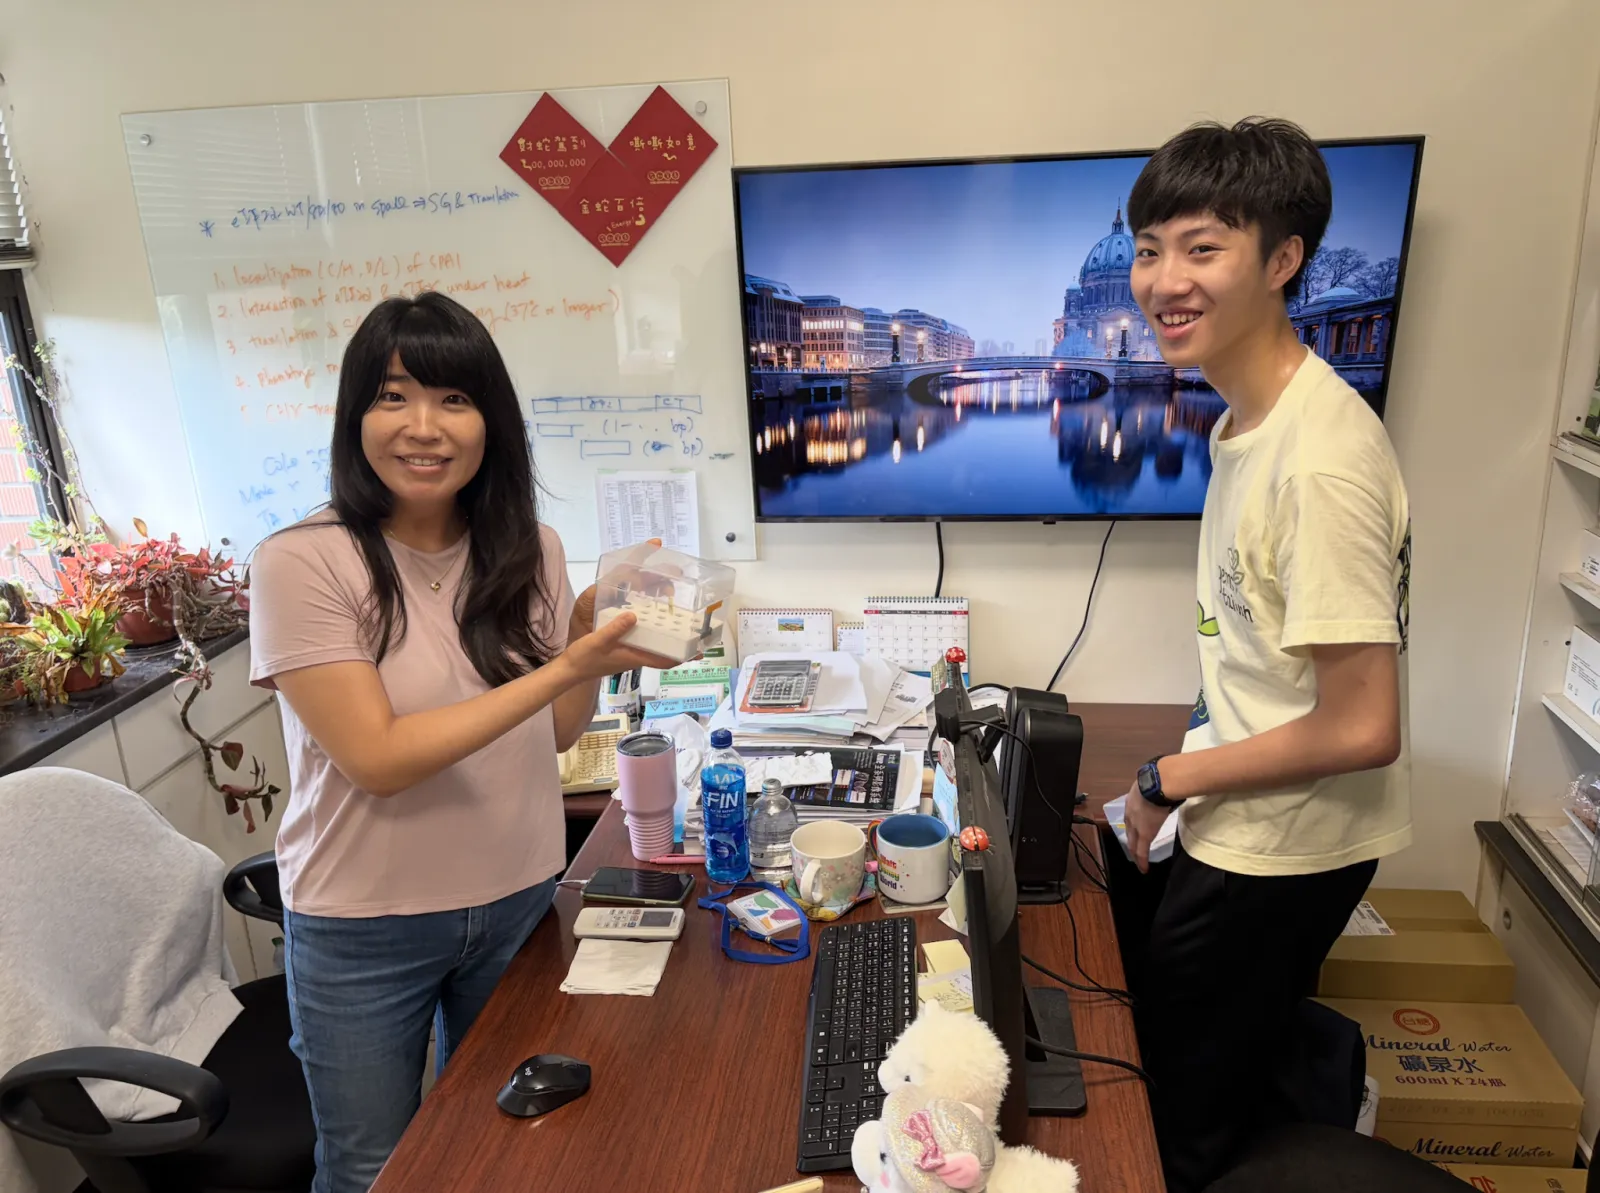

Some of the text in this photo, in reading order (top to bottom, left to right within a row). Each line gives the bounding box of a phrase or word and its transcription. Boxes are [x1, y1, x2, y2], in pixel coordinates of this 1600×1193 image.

[629, 133, 696, 151] 嘶嘶如意
[580, 196, 645, 215] 金蛇百倍
[493, 270, 531, 292] heat
[707, 791, 739, 809] FIN
[1458, 1042, 1512, 1052] Water
[1396, 1054, 1484, 1073] 礦泉水
[1395, 1075, 1449, 1085] 600ml
[1411, 1137, 1555, 1158] Mineral Water
